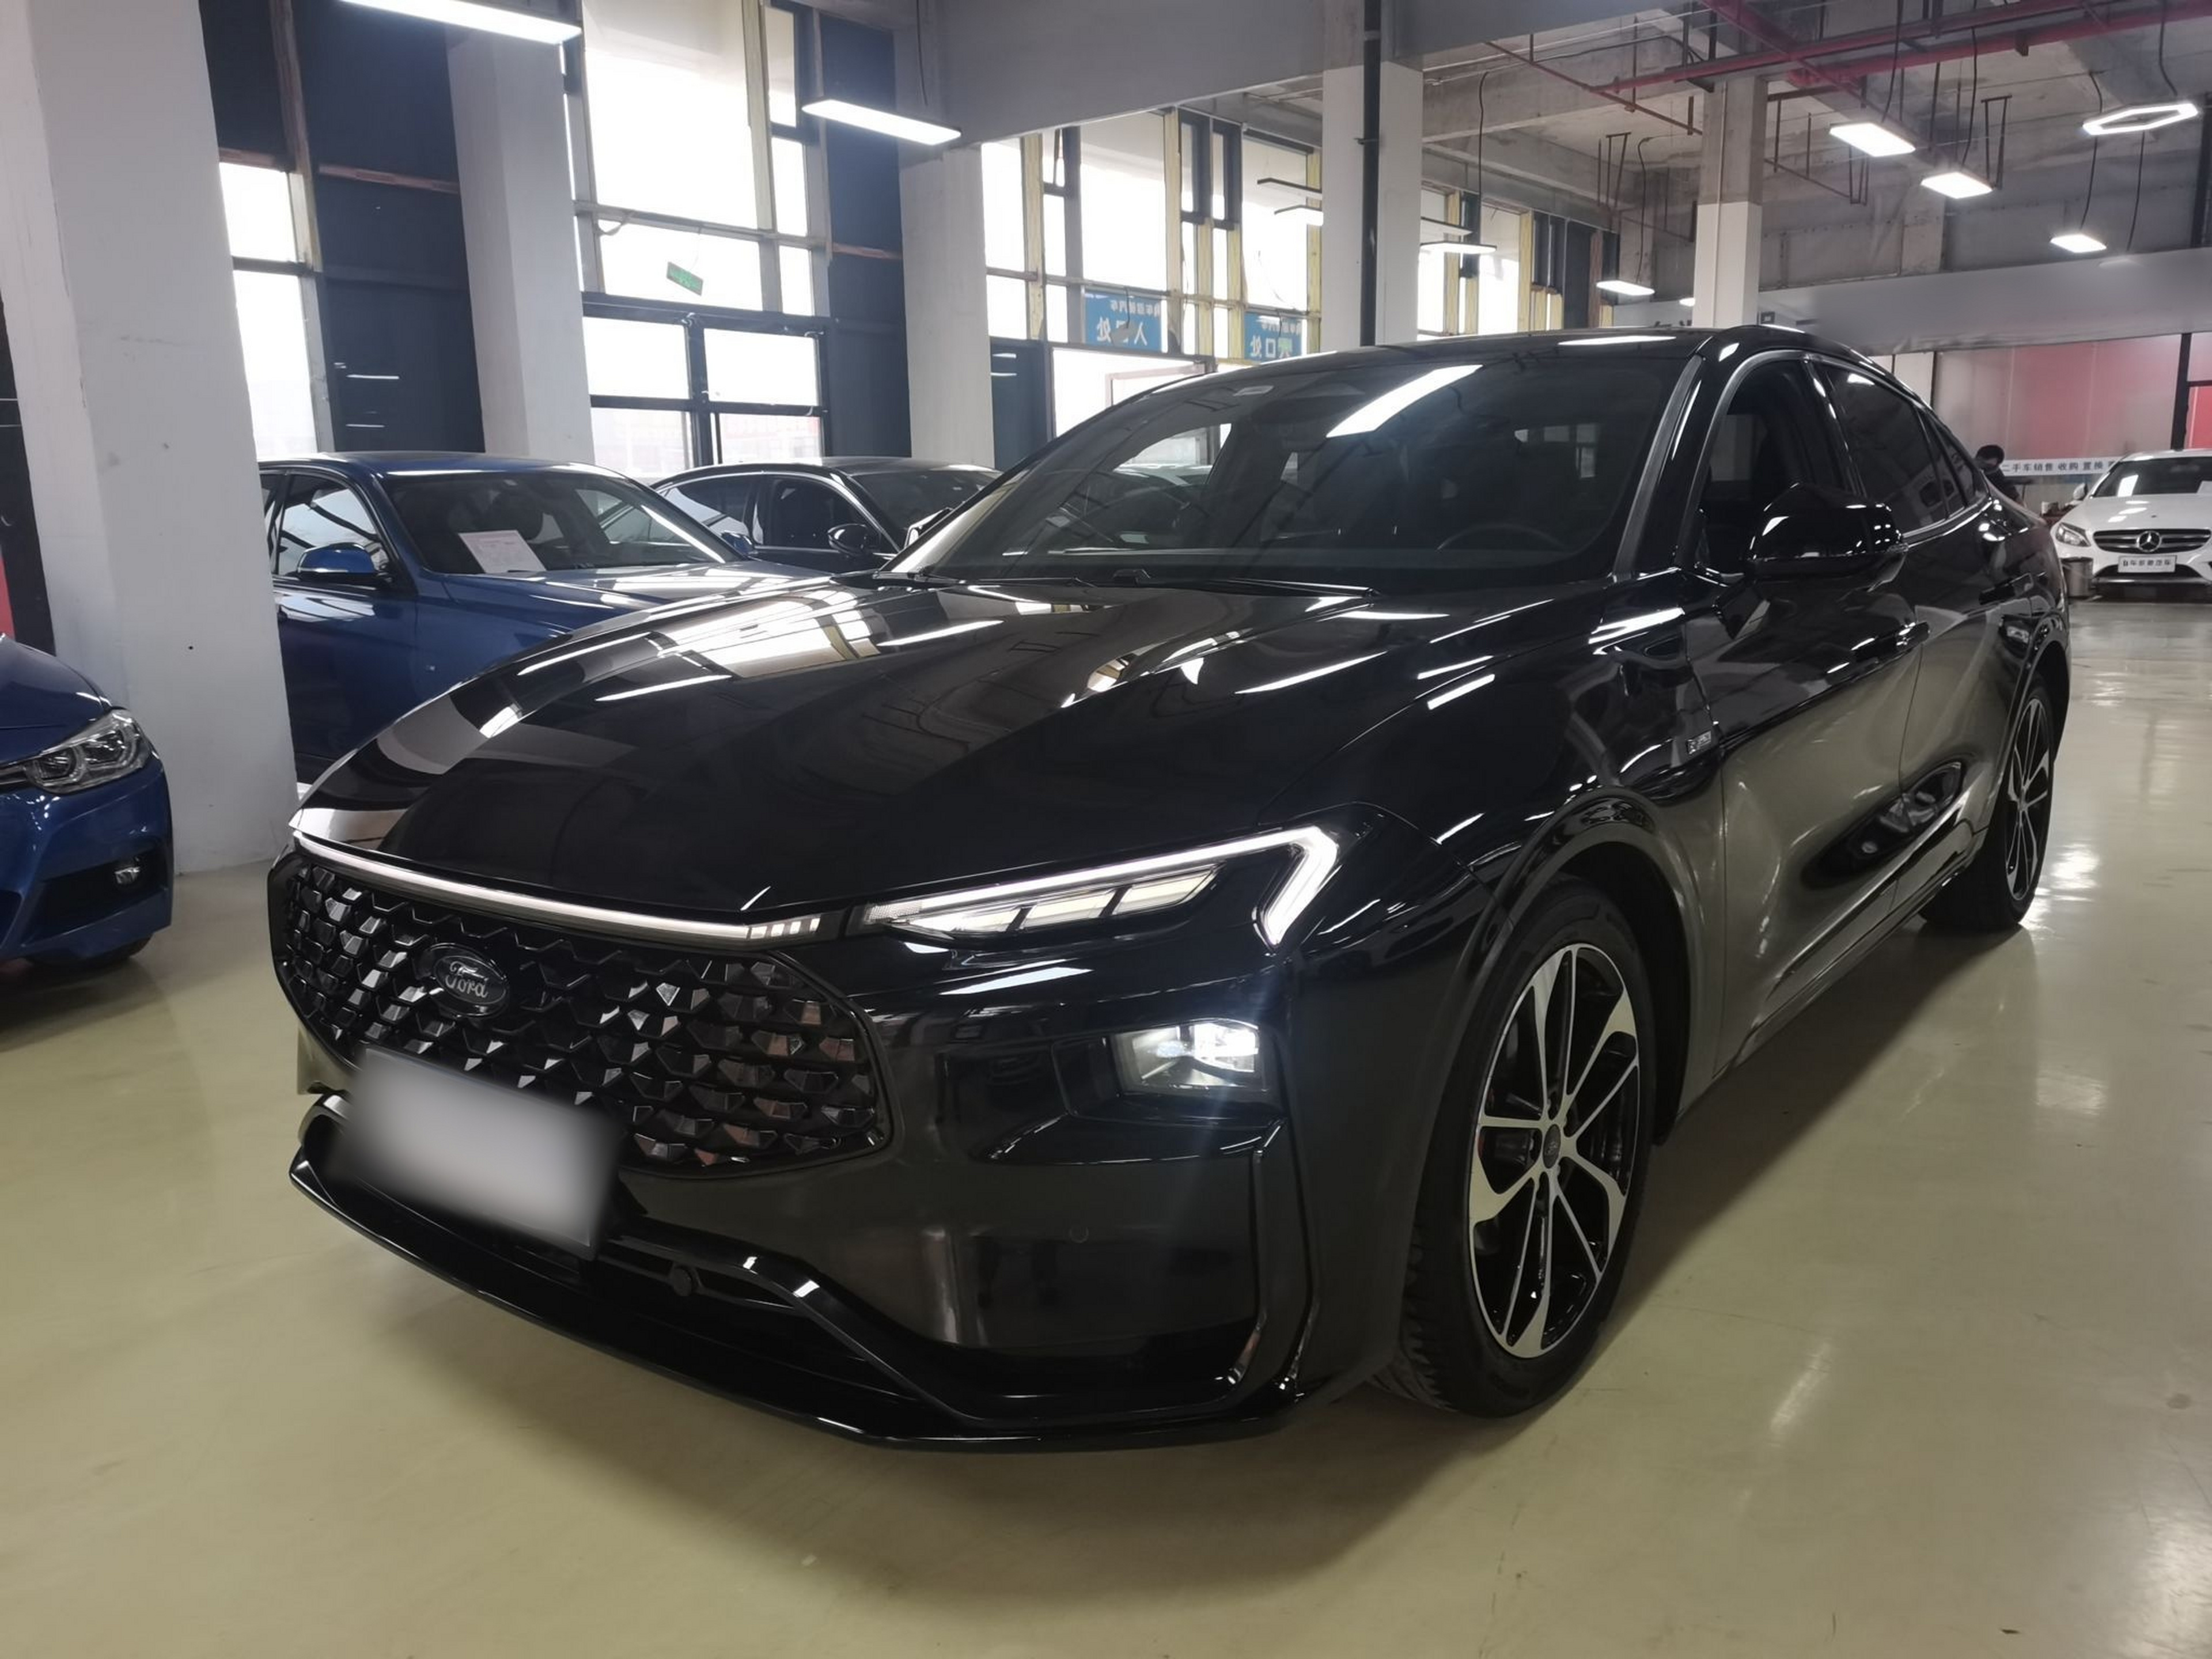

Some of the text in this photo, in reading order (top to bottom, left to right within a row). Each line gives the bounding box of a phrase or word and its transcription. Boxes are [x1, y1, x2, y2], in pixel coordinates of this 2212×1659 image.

[2002, 463, 2052, 473] 二手车销售
[2058, 462, 2078, 471] 收购
[445, 960, 489, 999] Ford
